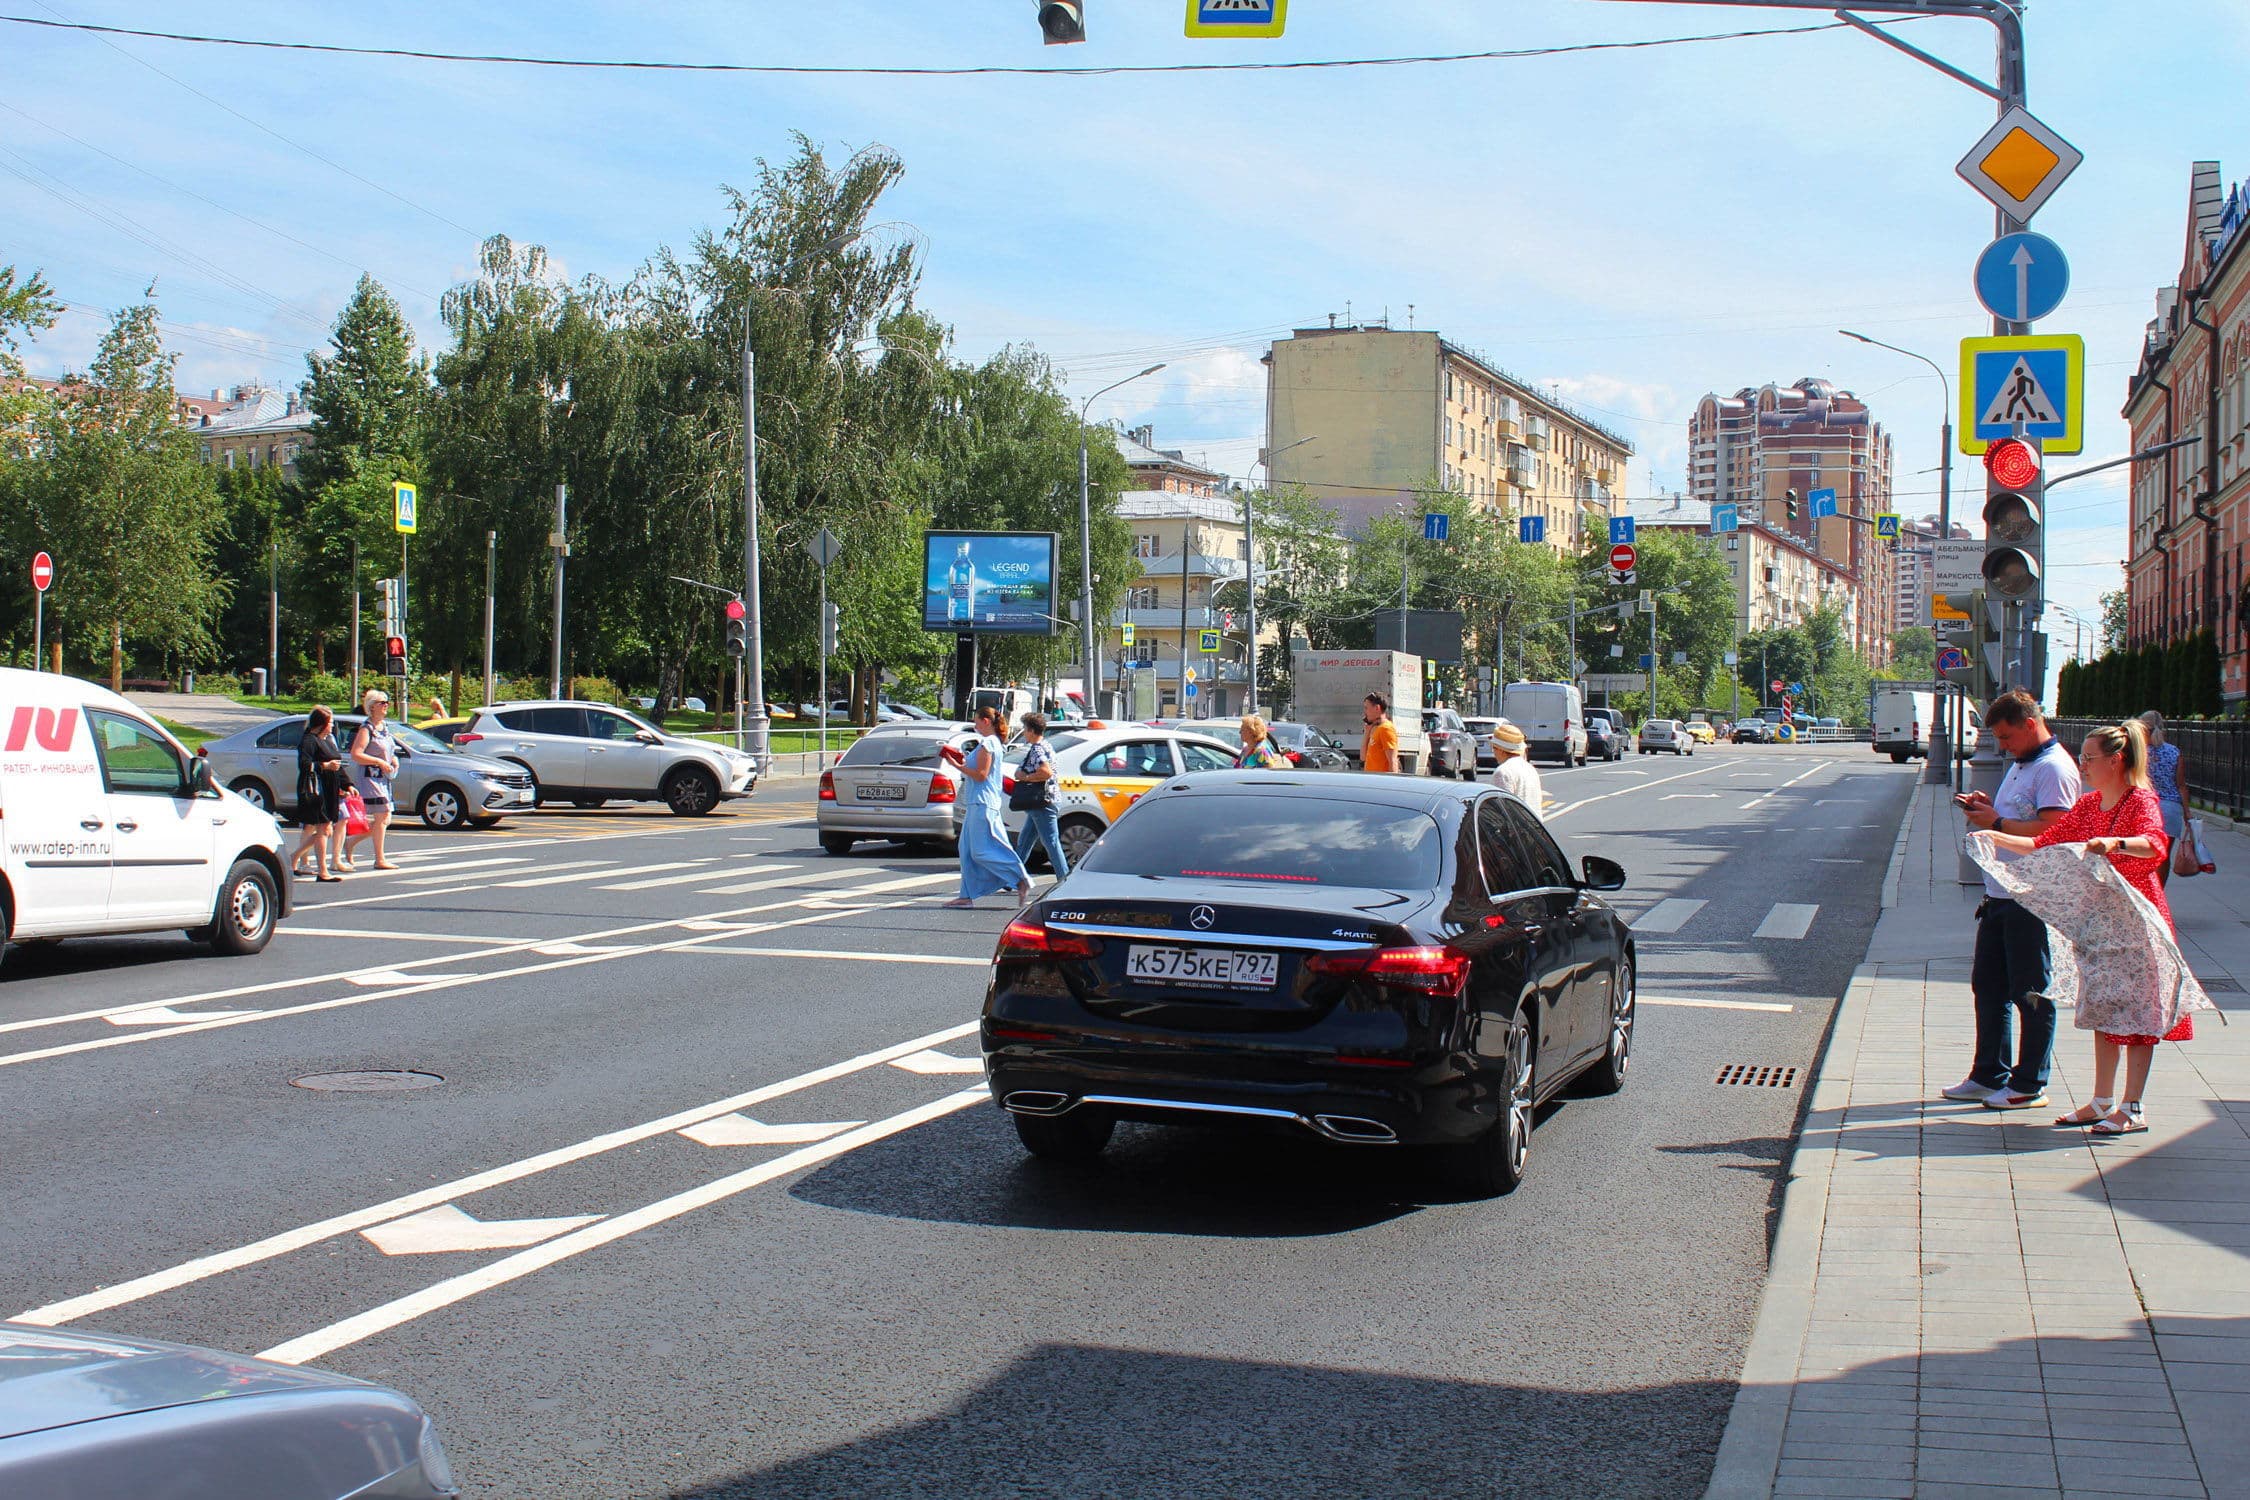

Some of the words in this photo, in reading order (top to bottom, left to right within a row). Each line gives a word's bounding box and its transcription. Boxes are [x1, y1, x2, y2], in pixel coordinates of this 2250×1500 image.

[992, 562, 1030, 572] LEGEND
[1320, 659, 1339, 667] МИР
[1343, 659, 1381, 667] ДЕРЕВА
[40, 764, 96, 774] ИННОВАЦИЯ
[10, 841, 110, 857] www.ratep-inn.ru
[1050, 911, 1060, 919] E
[1060, 911, 1086, 920] 200
[1332, 928, 1377, 939] 4MATIC
[1135, 949, 1229, 978] К575КЕ
[1235, 954, 1272, 974] 797
[1242, 973, 1260, 981] RUS
